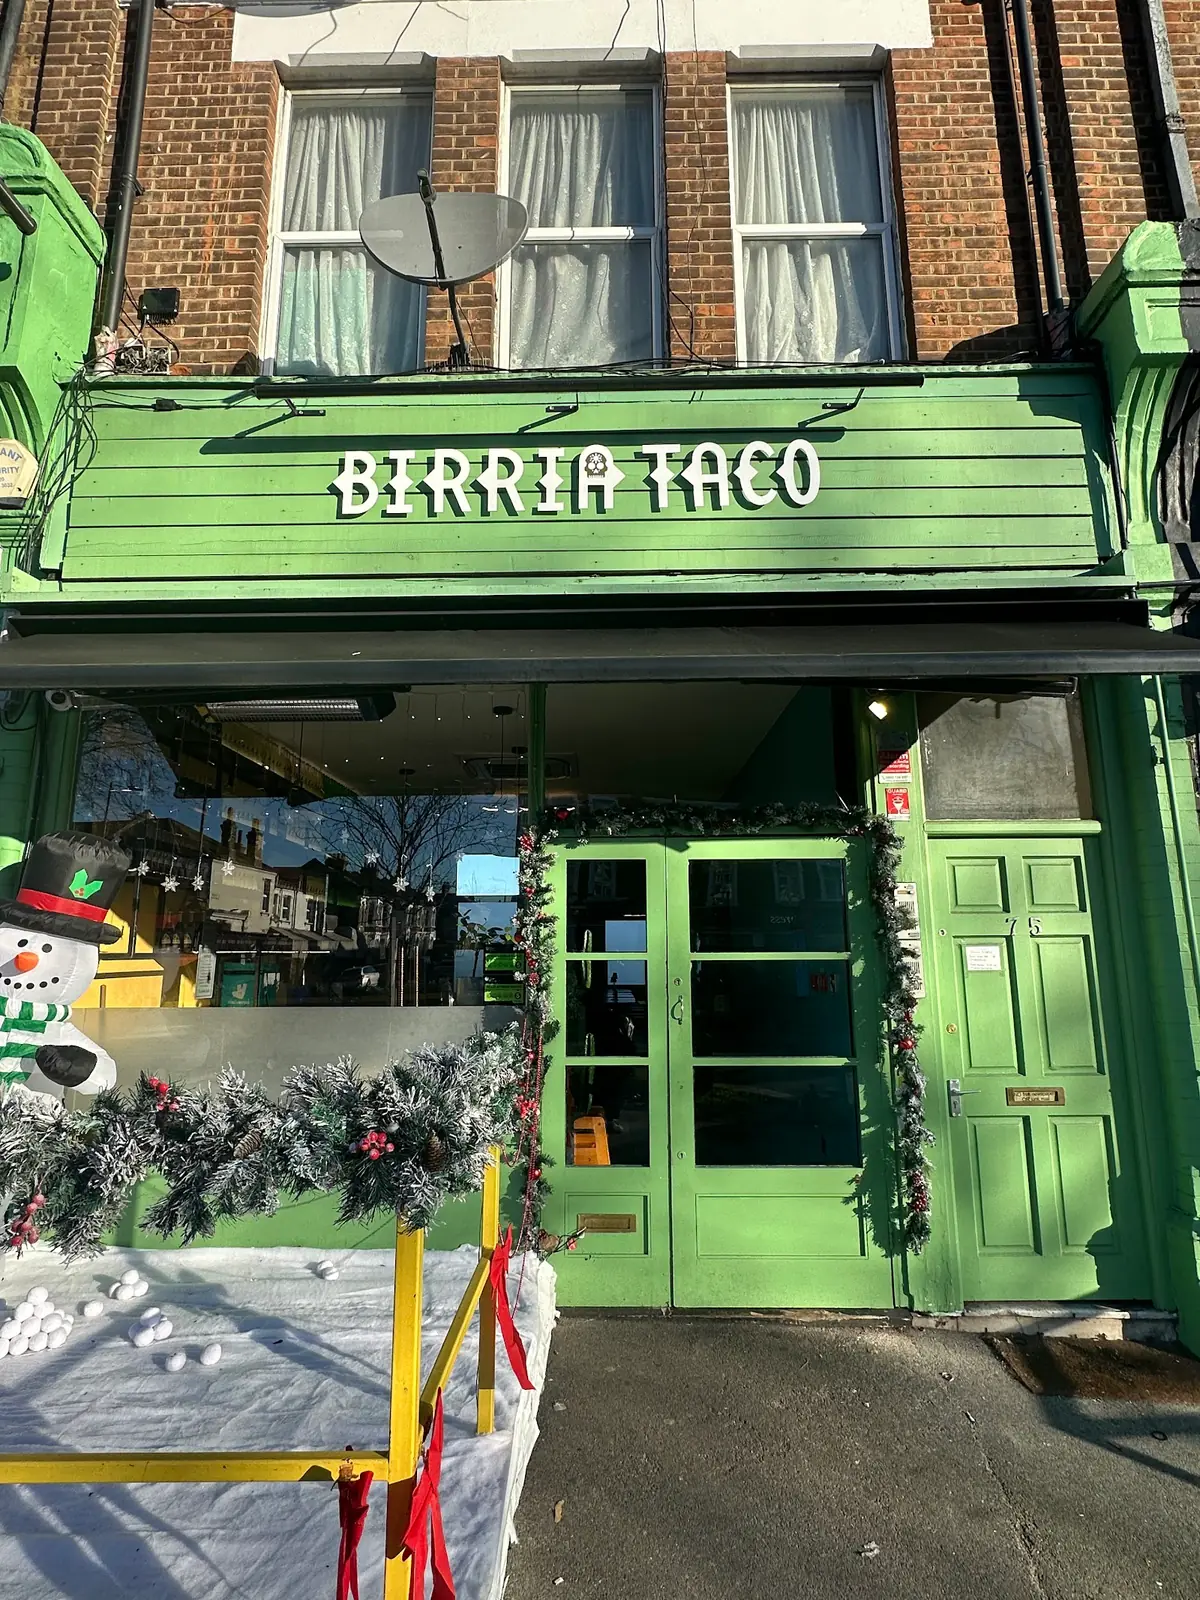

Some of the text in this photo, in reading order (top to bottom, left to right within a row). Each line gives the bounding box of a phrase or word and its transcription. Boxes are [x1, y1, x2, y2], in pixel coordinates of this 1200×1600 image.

[0, 466, 20, 474] RITY
[332, 438, 821, 514] BIRRIA TACO
